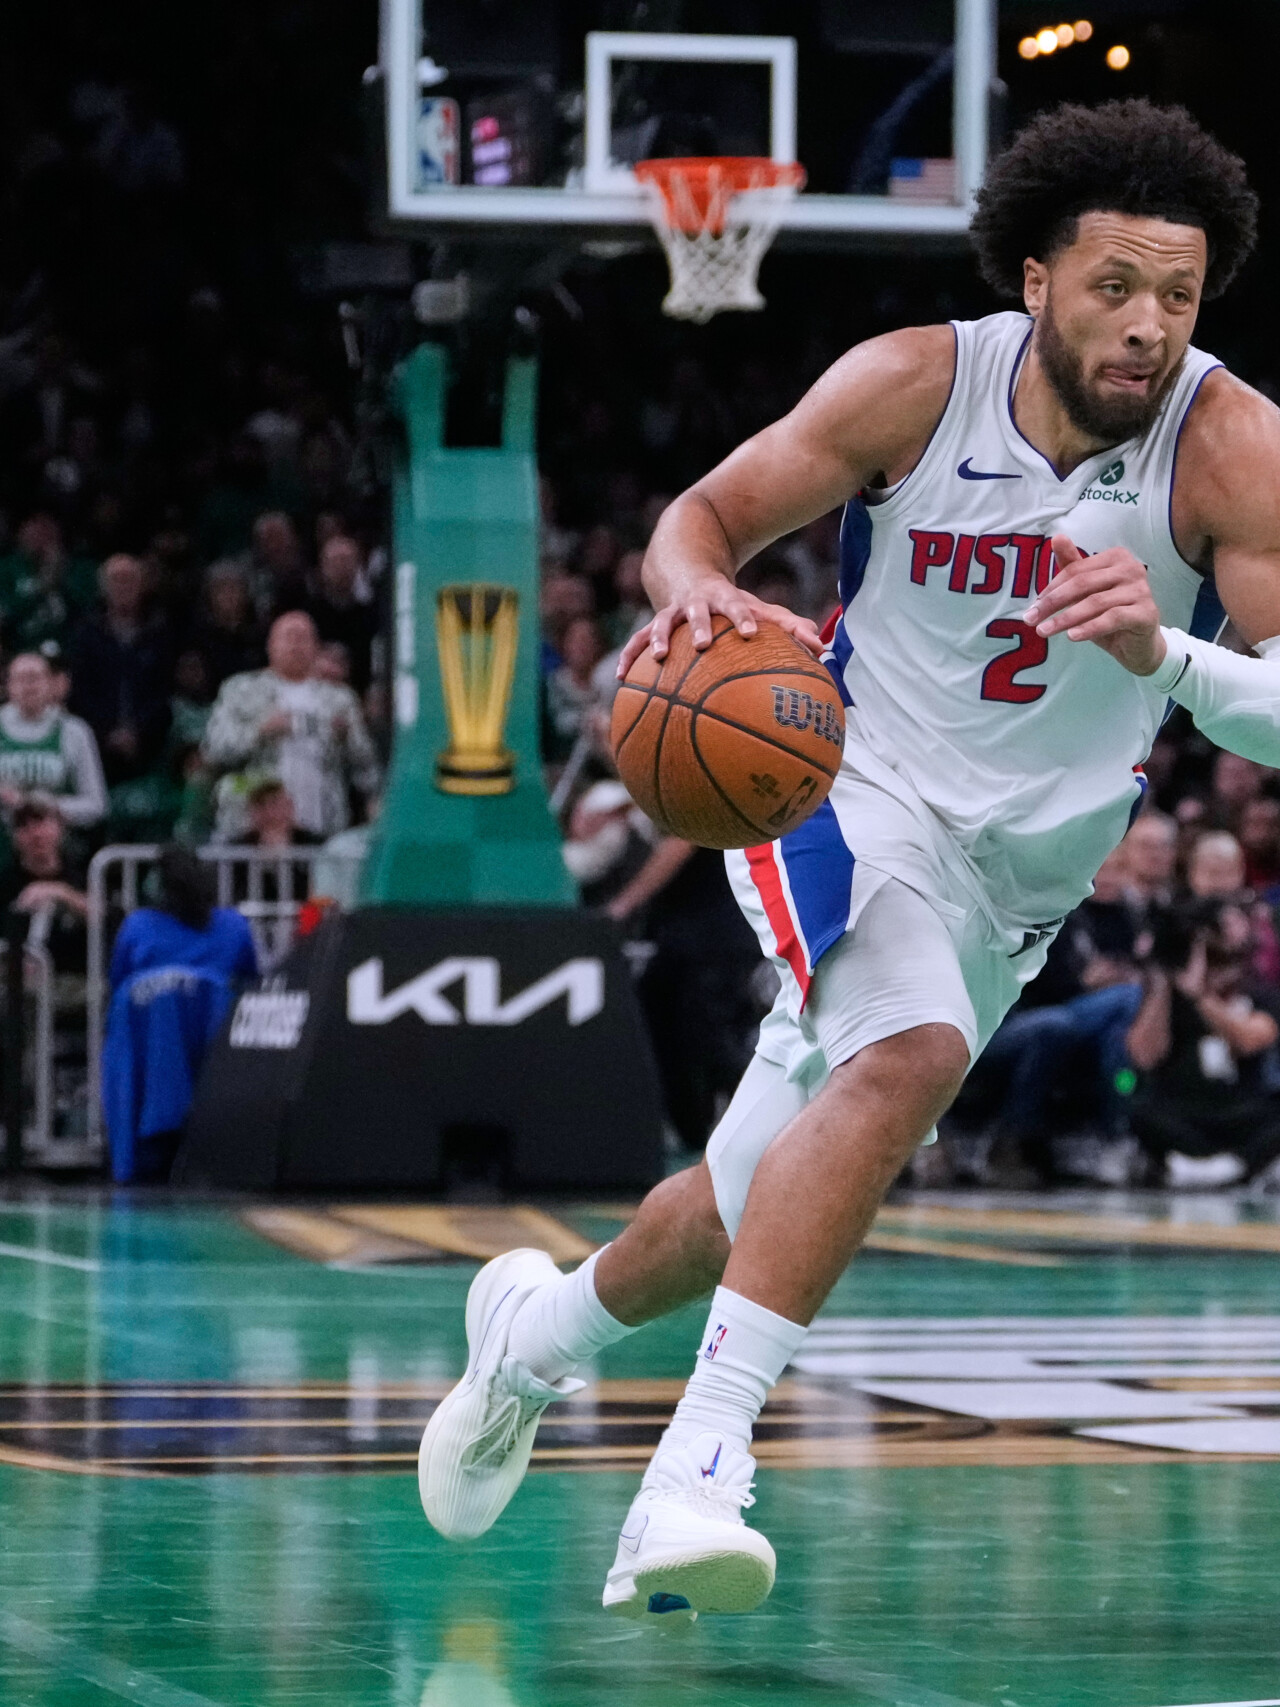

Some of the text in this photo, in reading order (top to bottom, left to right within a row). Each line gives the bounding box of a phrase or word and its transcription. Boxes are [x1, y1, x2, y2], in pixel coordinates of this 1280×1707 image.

[908, 528, 1148, 599] PISTO
[980, 618, 1049, 705] 2
[770, 684, 845, 747] Wils
[346, 956, 605, 1026] KIA
